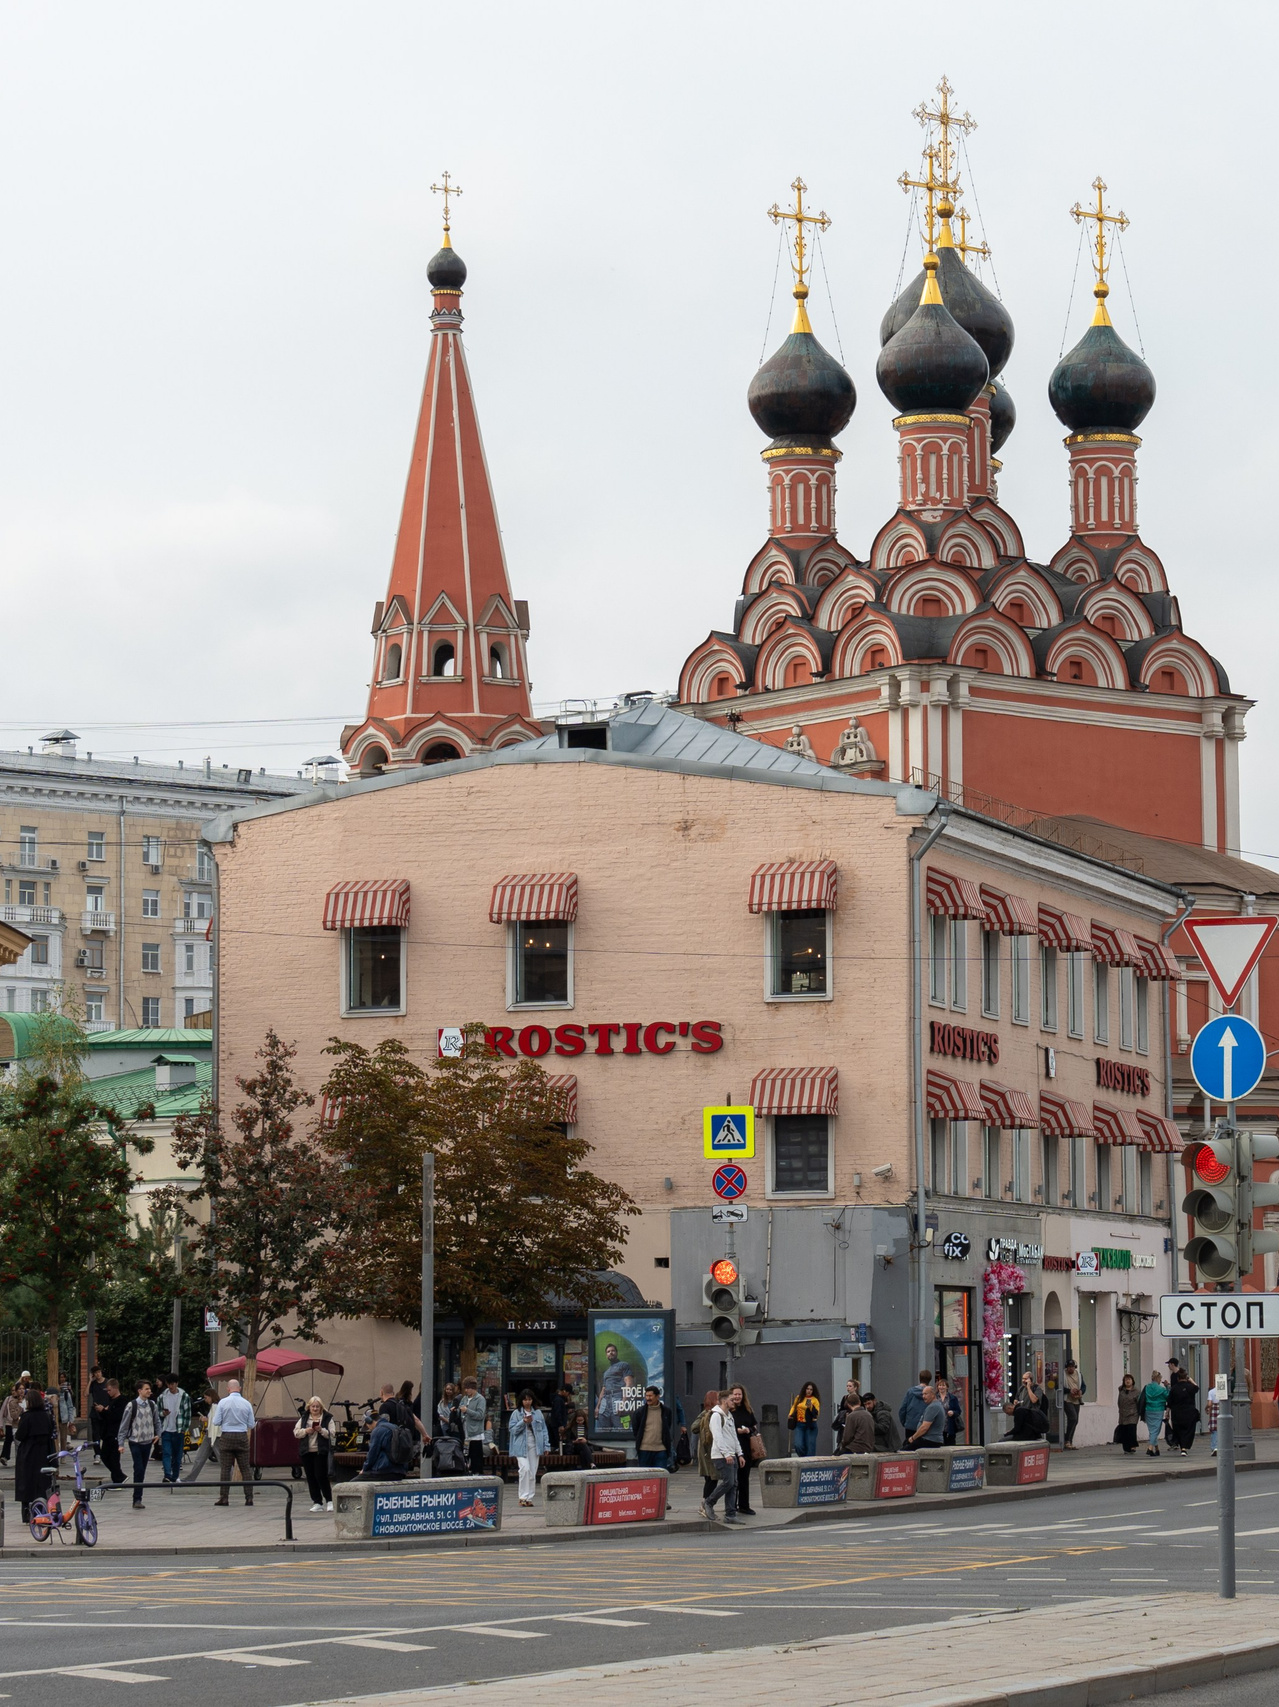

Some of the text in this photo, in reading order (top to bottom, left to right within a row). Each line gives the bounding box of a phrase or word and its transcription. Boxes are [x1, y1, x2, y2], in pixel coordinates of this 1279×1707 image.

[484, 1021, 725, 1058] ROSTIC'S
[932, 1021, 1000, 1064] ROSTIC'S
[1098, 1058, 1151, 1096] ROSTIC'S
[944, 1243, 962, 1257] fix
[1043, 1255, 1073, 1271] ROSTIC'S
[1177, 1302, 1264, 1329] СТОП
[621, 1384, 642, 1398] ТВОЁ
[614, 1398, 636, 1413] ТВОЙ
[376, 1494, 420, 1510] РЫБНЫЕ
[421, 1492, 456, 1508] РЫНКИ
[379, 1522, 440, 1534] НОВОУХТОМСКОЕ
[466, 1520, 475, 1528] 2А
